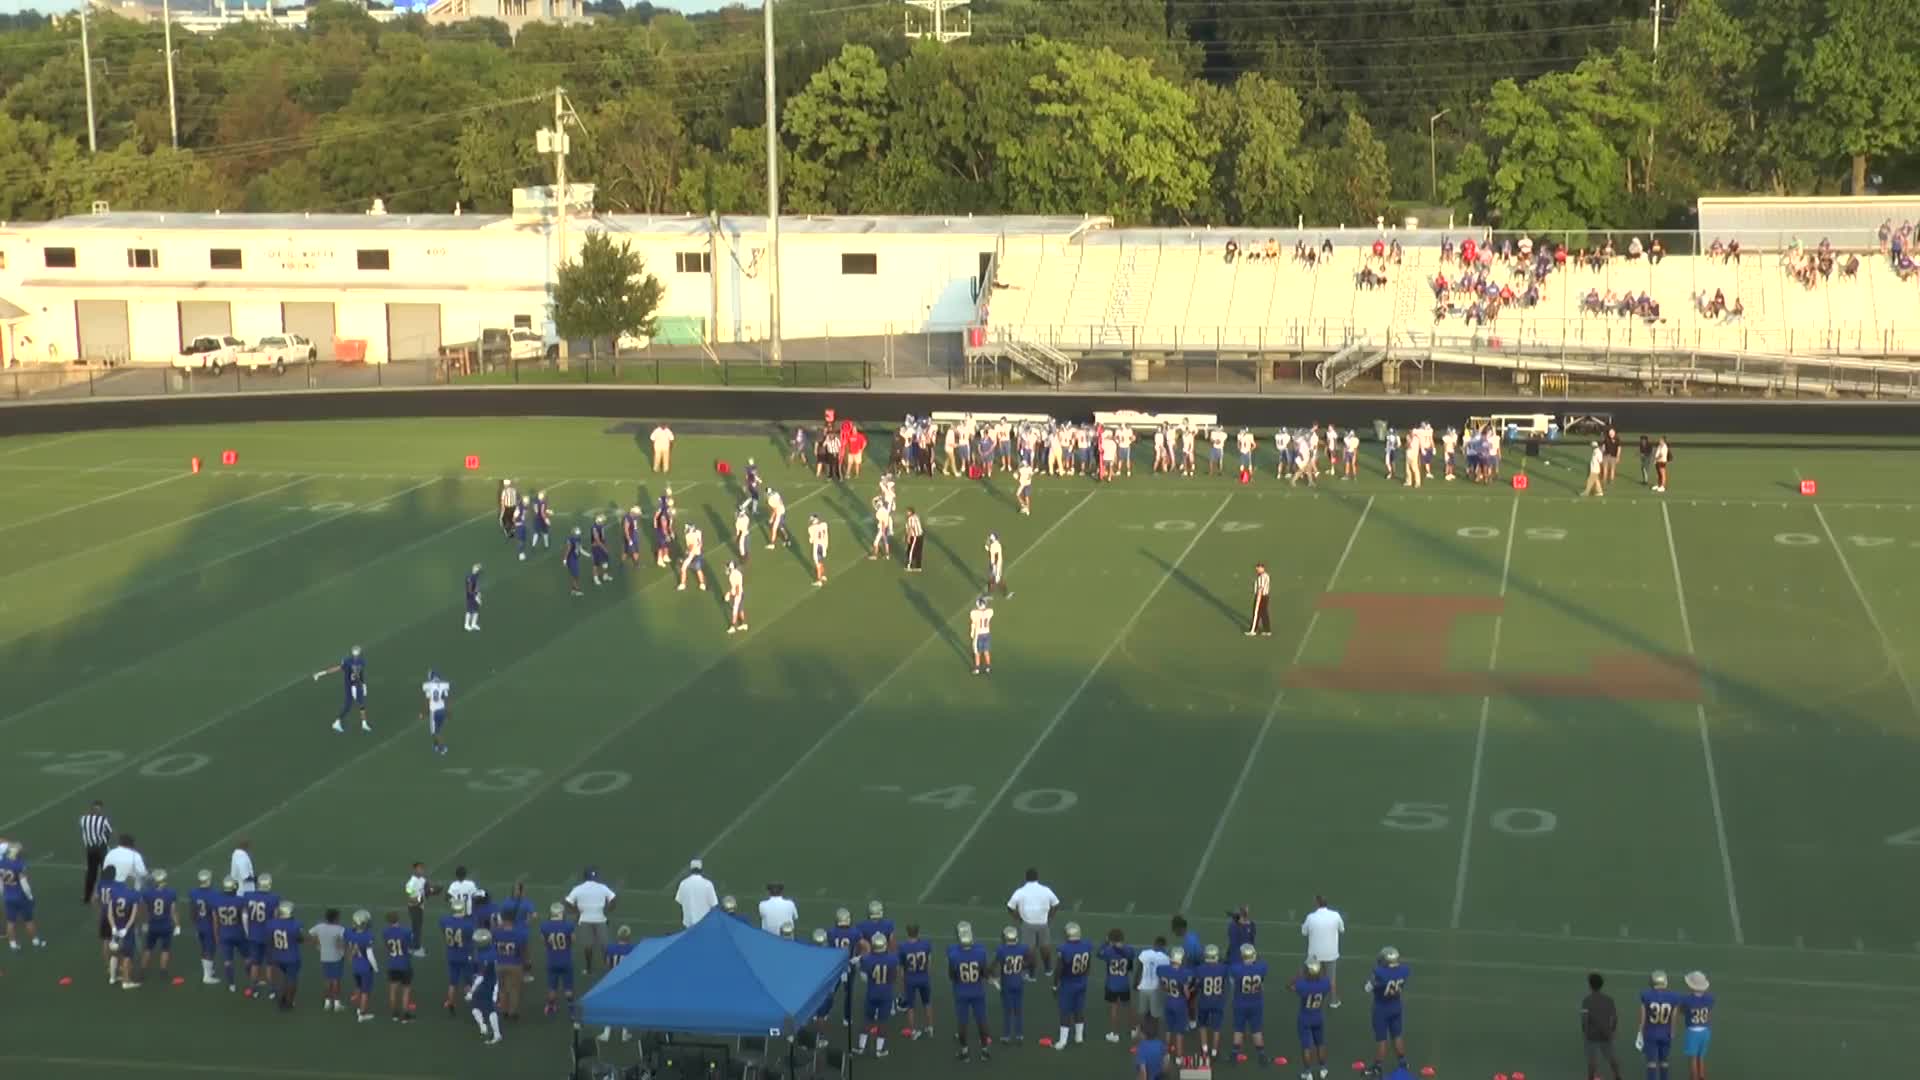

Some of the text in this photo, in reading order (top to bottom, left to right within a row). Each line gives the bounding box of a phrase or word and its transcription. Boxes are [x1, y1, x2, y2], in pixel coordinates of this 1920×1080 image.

[218, 906, 238, 925] 52
[248, 900, 266, 922] 76
[273, 929, 288, 949] 61
[387, 939, 403, 957] 31
[906, 952, 926, 971] 37
[872, 965, 888, 984] 41
[1649, 1002, 1671, 1024] 30
